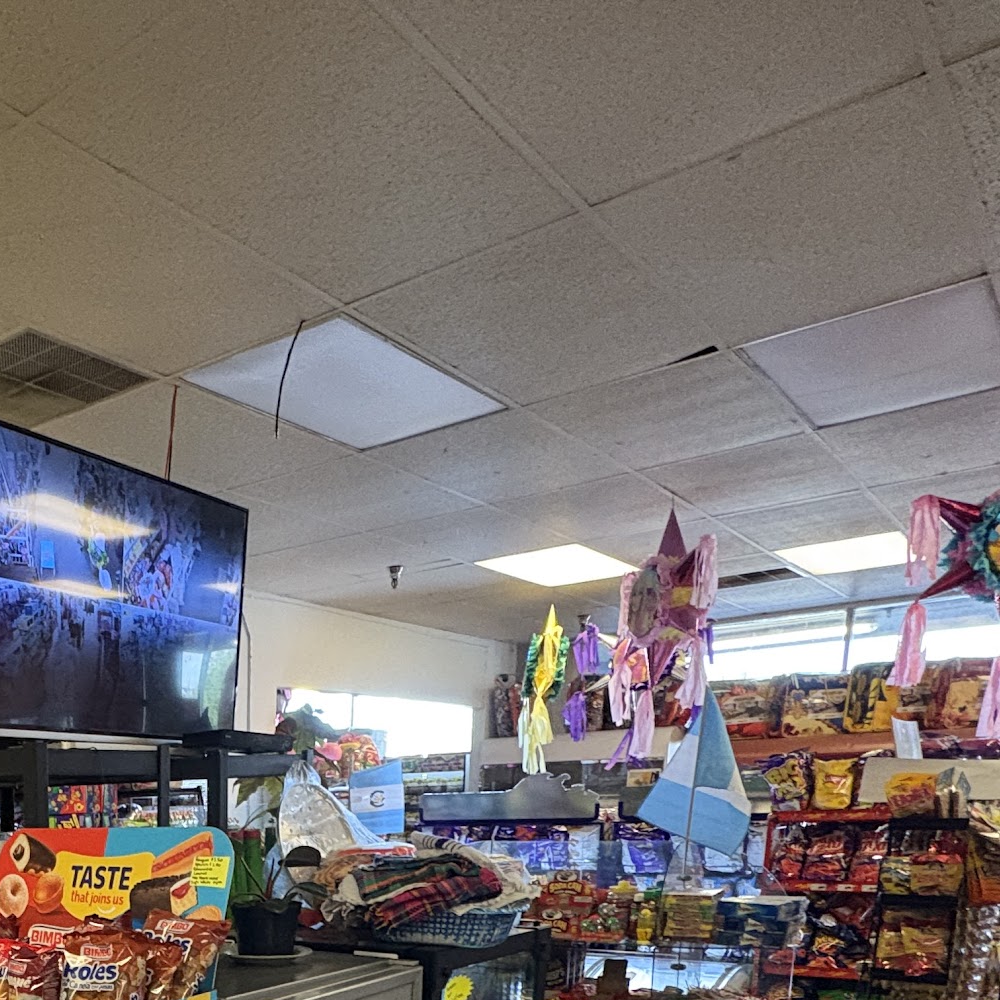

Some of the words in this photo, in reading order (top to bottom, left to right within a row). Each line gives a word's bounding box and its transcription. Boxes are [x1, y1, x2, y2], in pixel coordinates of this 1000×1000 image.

[71, 865, 132, 890] TASTE
[71, 890, 89, 903] that
[89, 892, 110, 906] joins
[112, 895, 124, 905] us
[31, 931, 66, 947] BIMB
